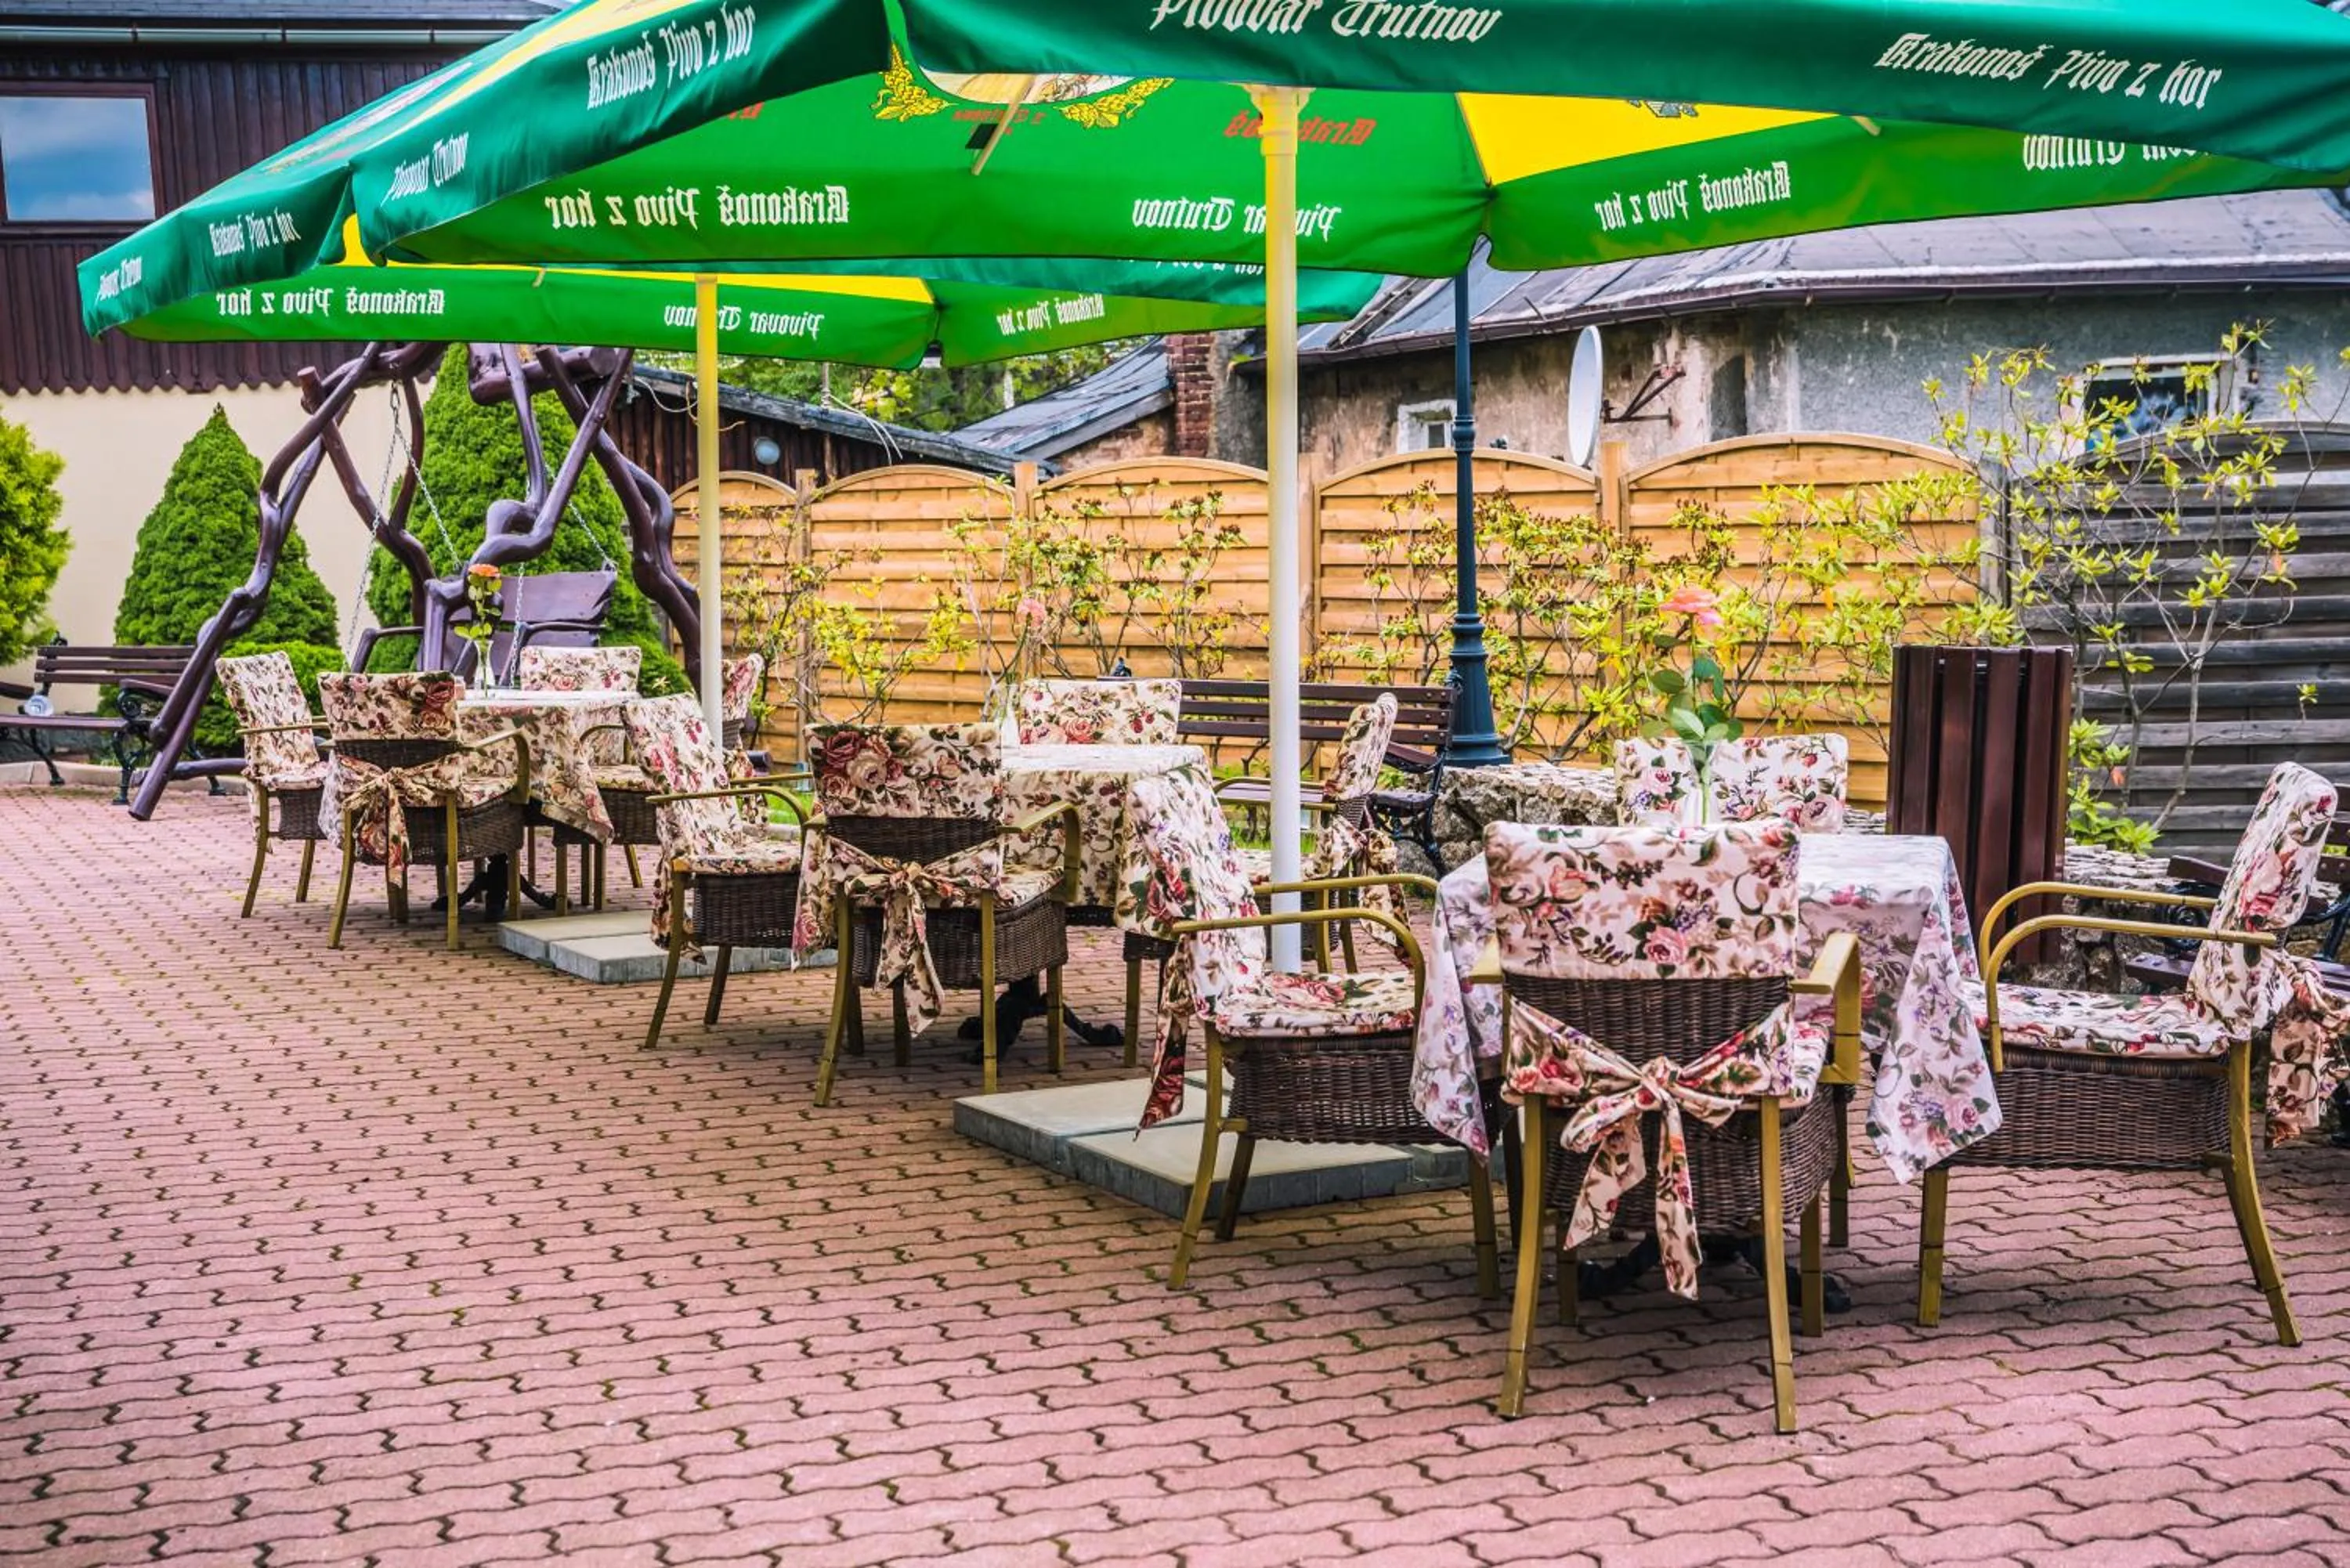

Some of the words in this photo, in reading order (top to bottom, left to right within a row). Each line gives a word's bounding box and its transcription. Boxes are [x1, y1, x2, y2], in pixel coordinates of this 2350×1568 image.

[659, 20, 703, 88] Pivo
[705, 20, 719, 67] z
[720, 1, 755, 62] hor
[1331, 0, 1503, 42] Trutnov
[1874, 33, 2054, 81] Krakonoš
[2043, 50, 2131, 93] Pivo
[2124, 62, 2162, 97] z
[2159, 59, 2222, 110] hor
